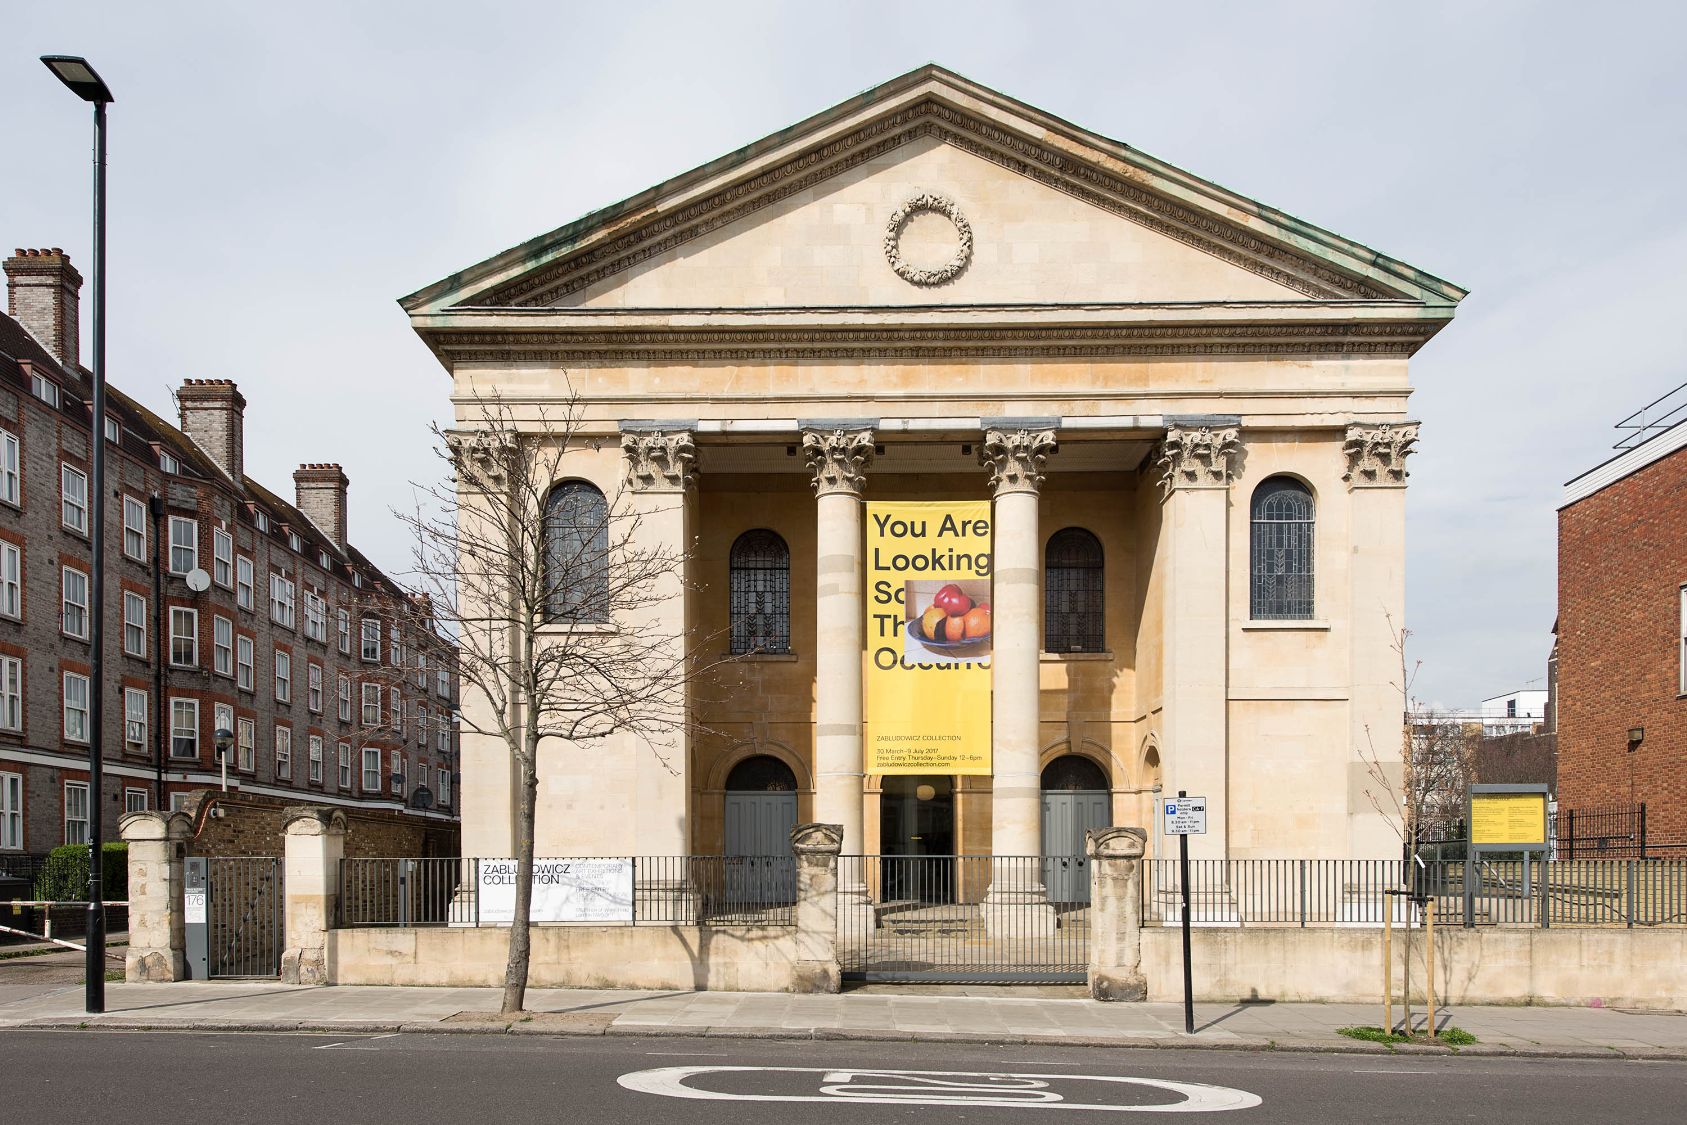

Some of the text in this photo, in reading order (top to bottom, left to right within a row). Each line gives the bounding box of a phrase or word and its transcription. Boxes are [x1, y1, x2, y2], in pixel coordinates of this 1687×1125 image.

[872, 513, 989, 538] You Are
[874, 547, 992, 577] Looking
[484, 864, 571, 874] ZABLUOWICZ
[484, 874, 560, 885] COLLTION
[186, 894, 204, 906] 176
